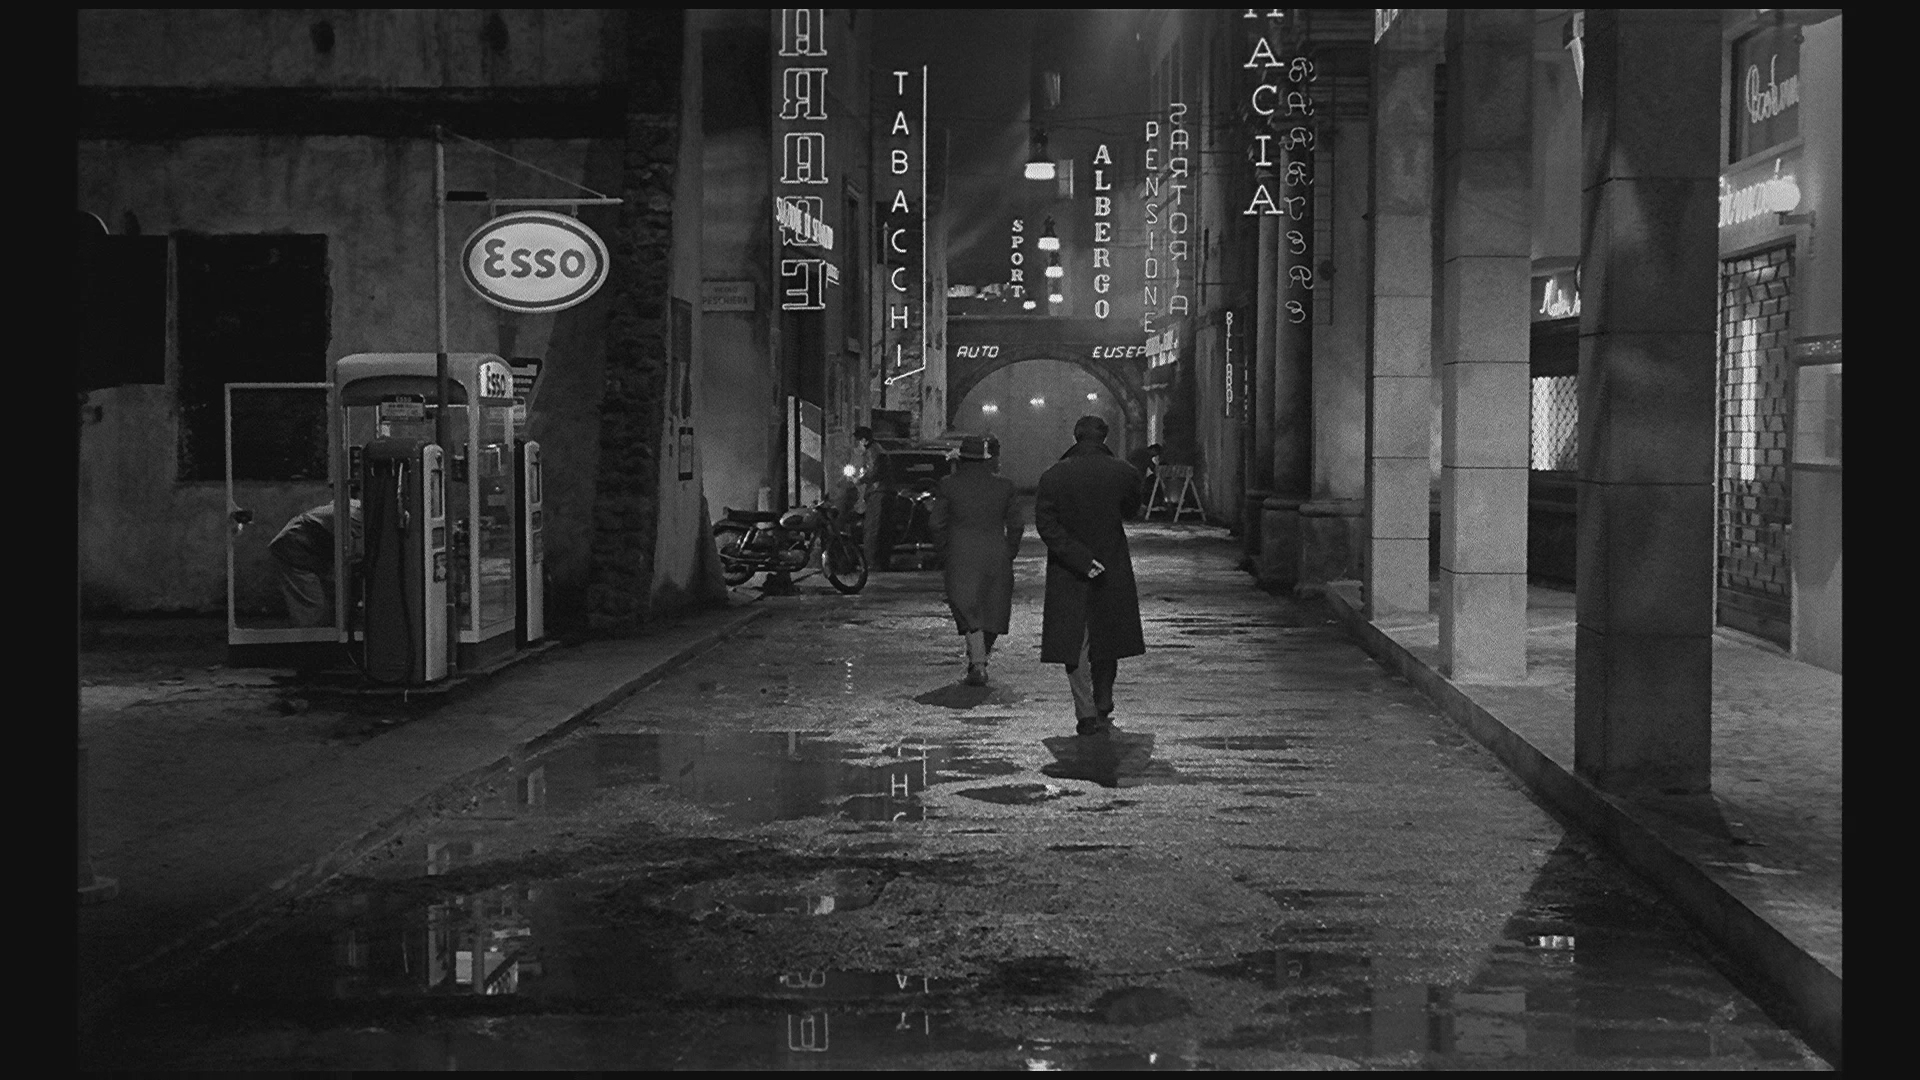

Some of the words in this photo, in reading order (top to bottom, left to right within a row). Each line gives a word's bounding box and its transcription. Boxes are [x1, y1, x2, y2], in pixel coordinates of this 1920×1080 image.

[1244, 9, 1285, 215] ACIA
[891, 72, 910, 367] TABACCHI
[1011, 220, 1025, 299] SPORT
[1093, 145, 1112, 319] ALBERGO
[1144, 121, 1160, 333] PENSIONE
[957, 346, 999, 358] AUTO
